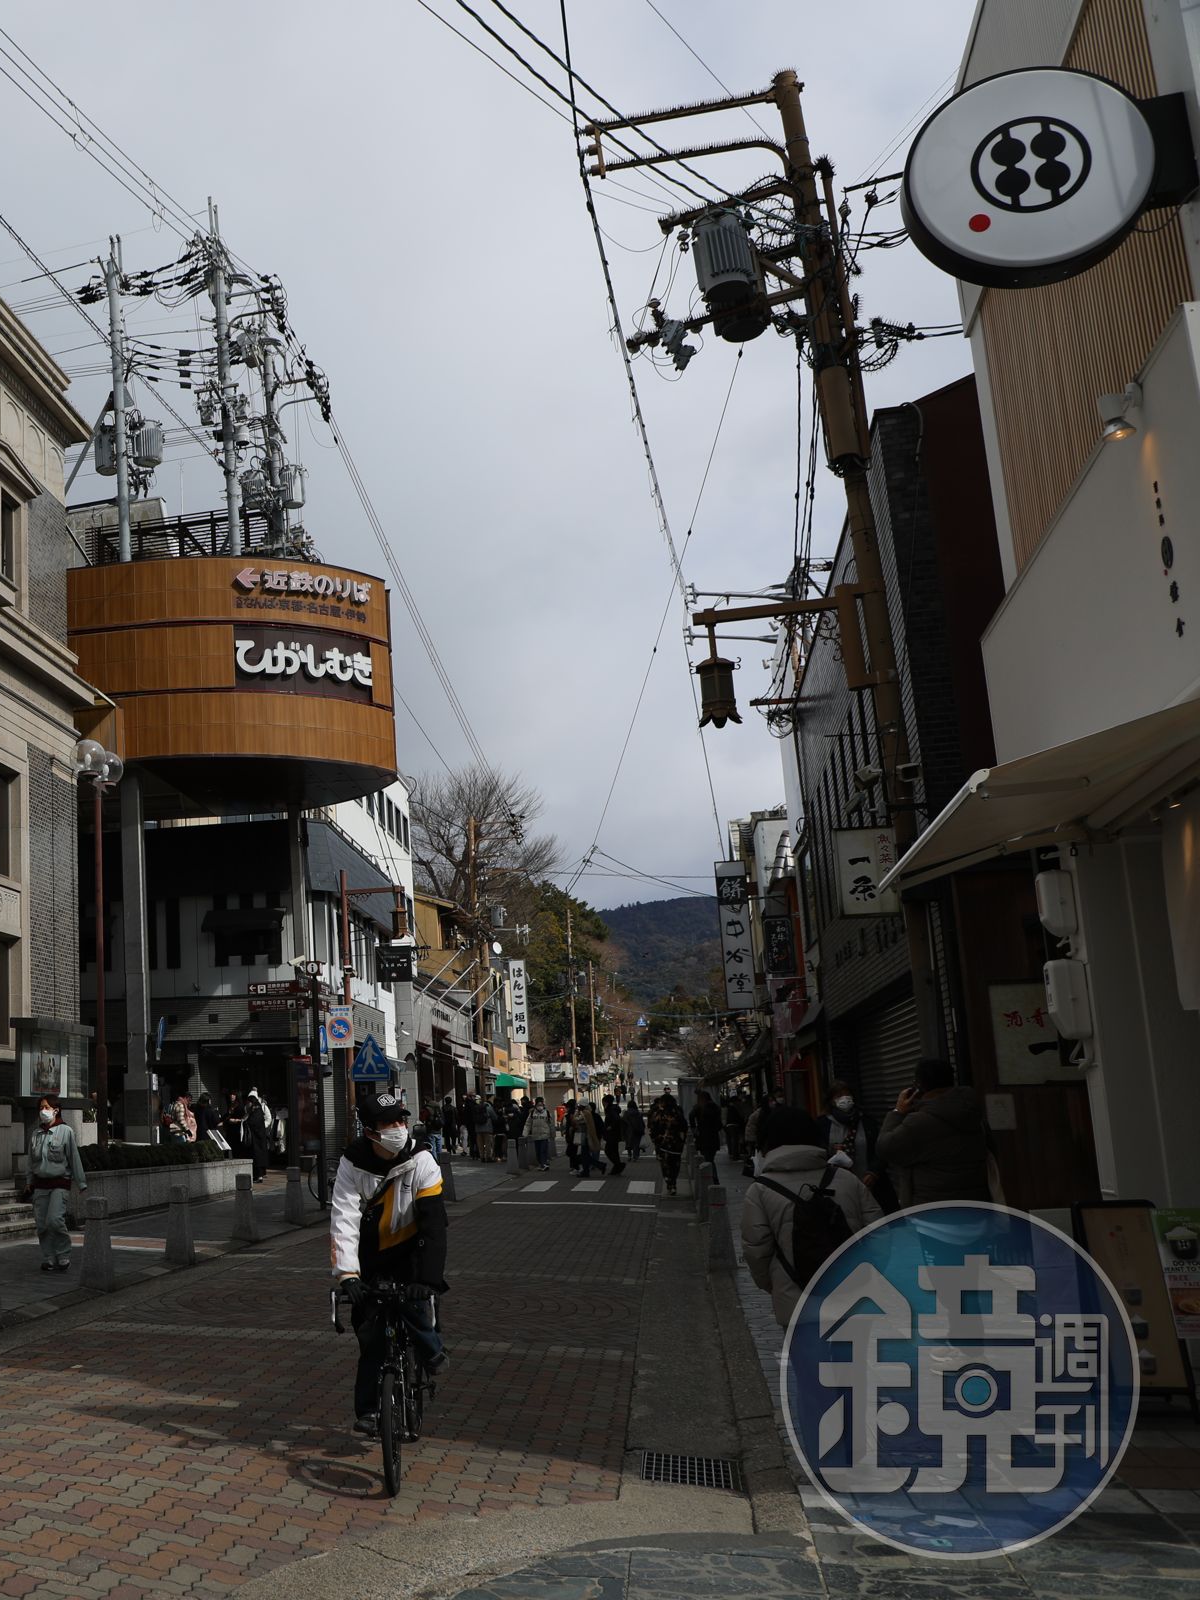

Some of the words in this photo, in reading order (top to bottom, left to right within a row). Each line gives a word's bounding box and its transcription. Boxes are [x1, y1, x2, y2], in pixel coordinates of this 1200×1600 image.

[264, 568, 371, 603] 近鉄のりば
[235, 639, 373, 686] ひがしむき
[719, 878, 745, 898] 餅
[512, 967, 524, 1006] はんこ
[514, 1012, 526, 1035] 垣内
